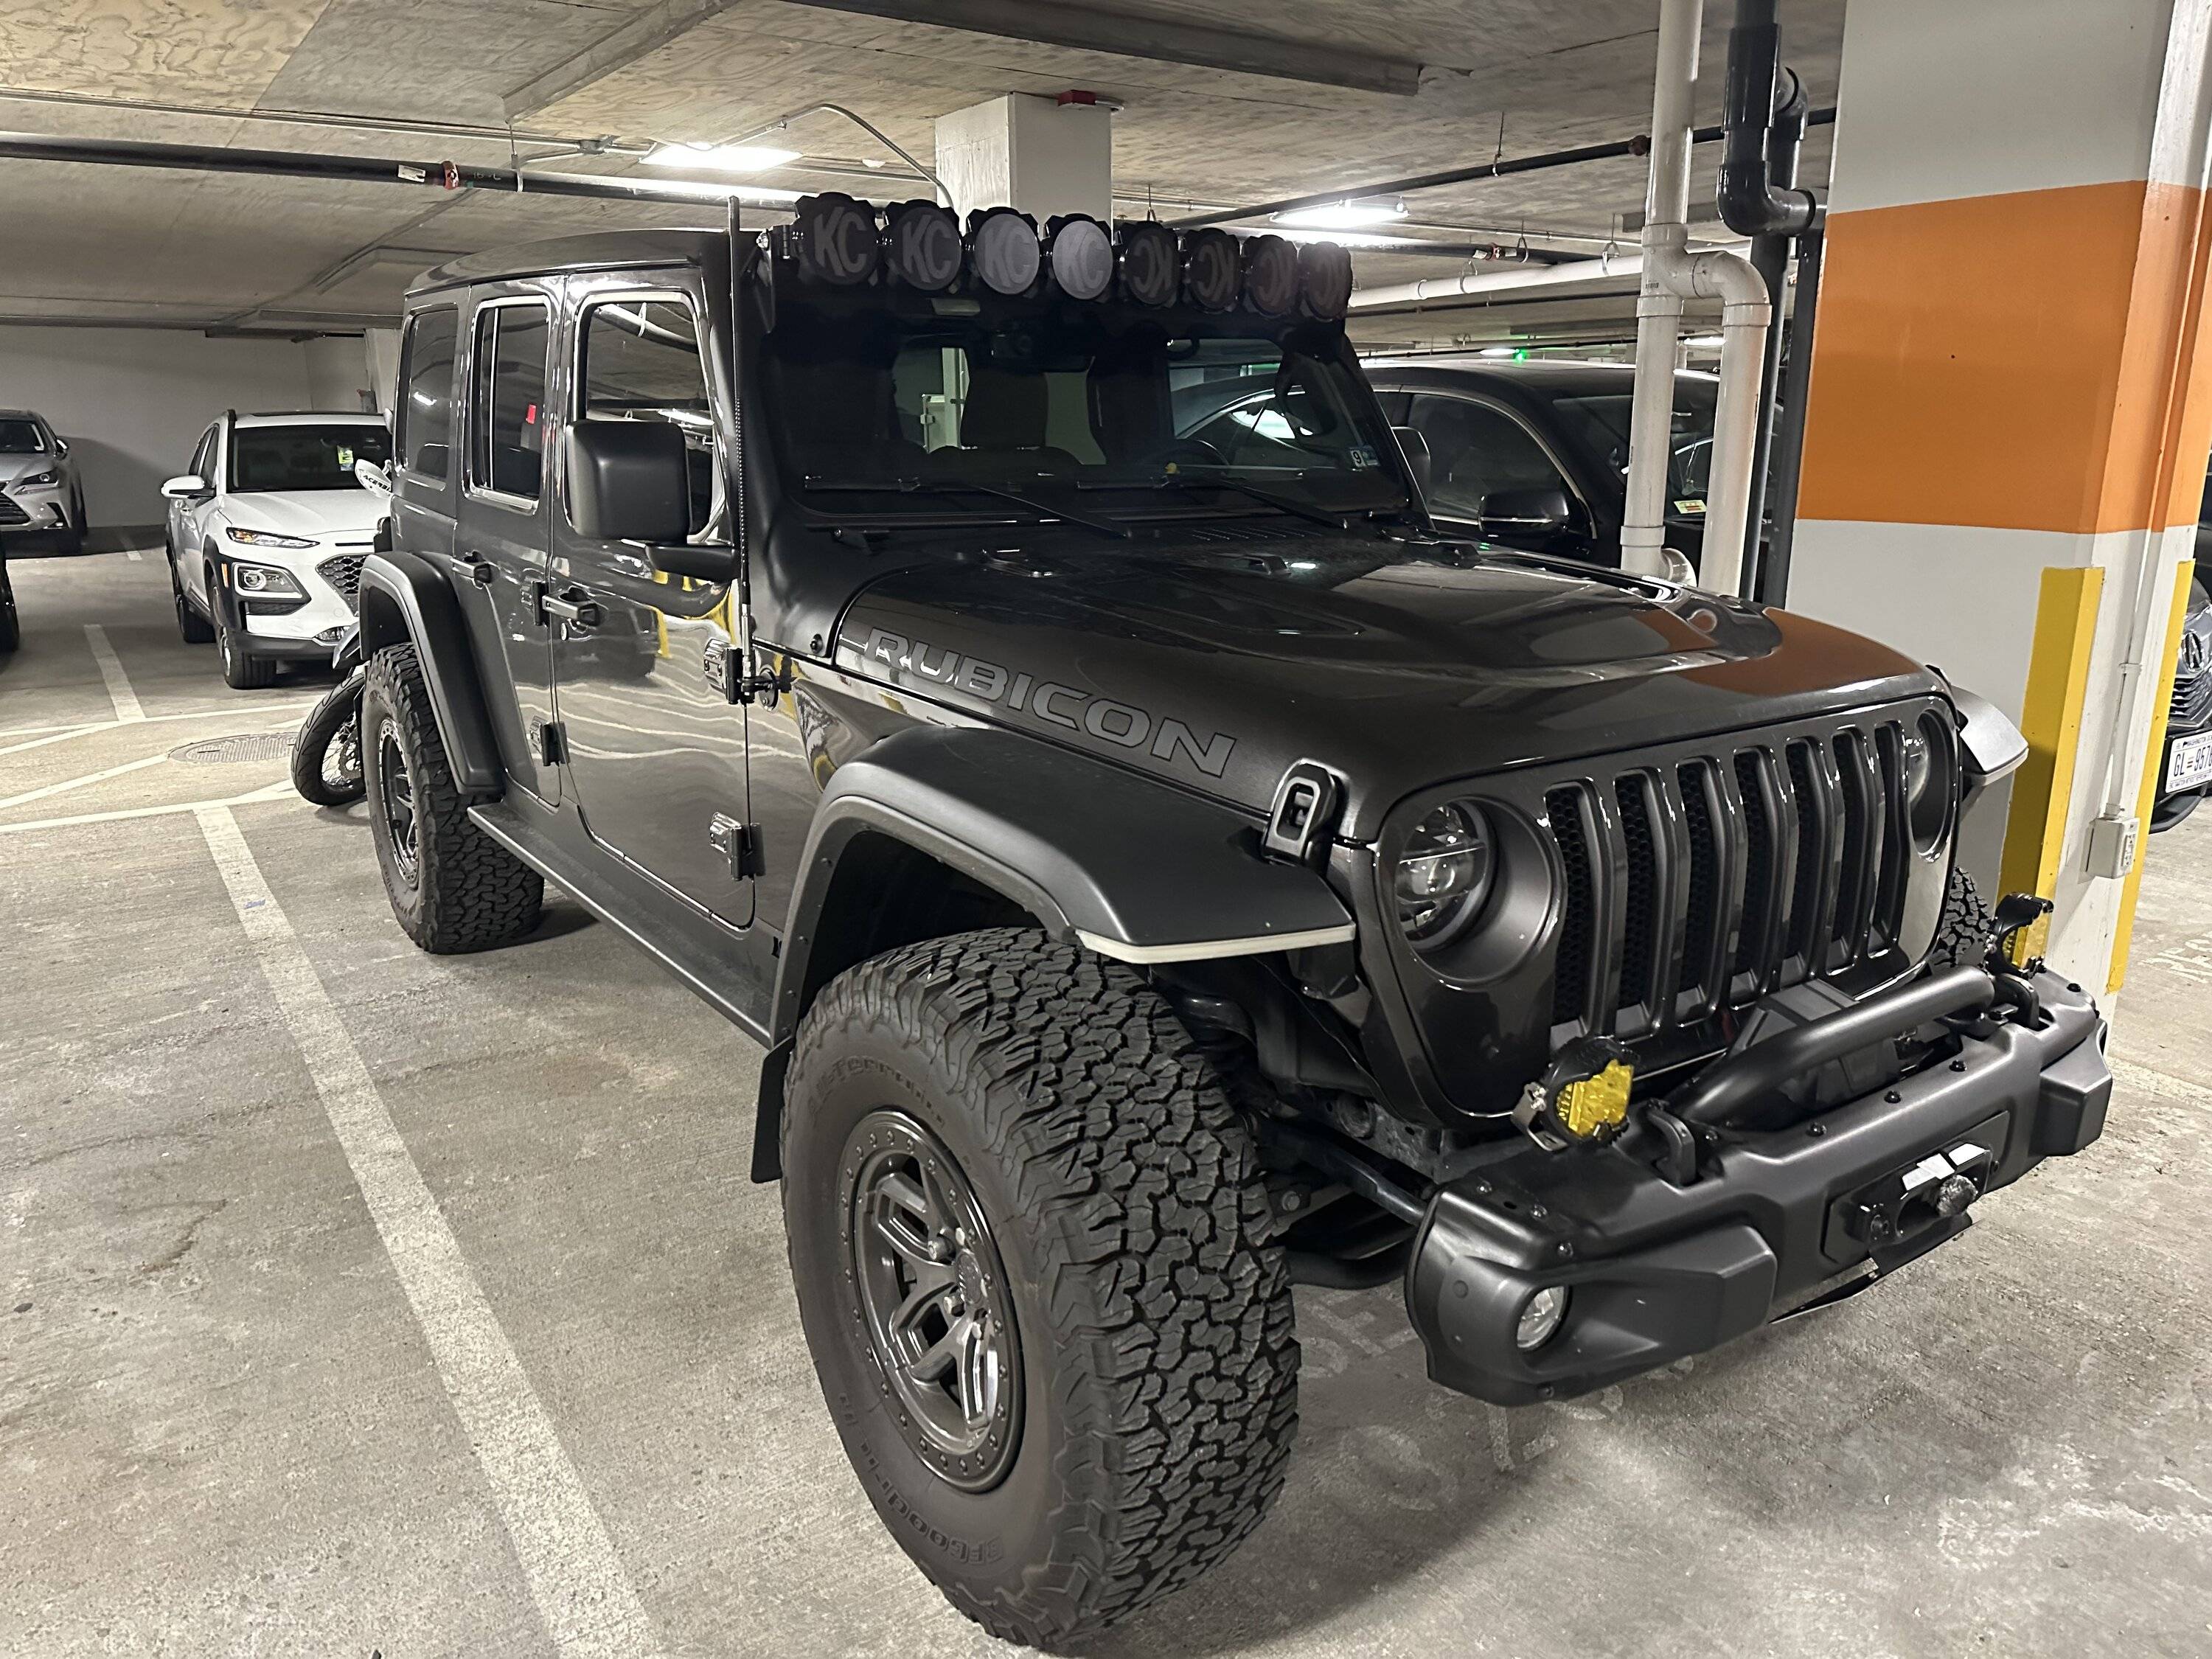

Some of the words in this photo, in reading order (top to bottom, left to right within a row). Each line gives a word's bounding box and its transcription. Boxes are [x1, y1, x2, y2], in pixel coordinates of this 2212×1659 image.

[814, 206, 867, 276] KC
[902, 215, 952, 282] KC
[984, 220, 1032, 288] KC
[1062, 229, 1104, 293] KC
[1353, 451, 1362, 464] 9
[864, 627, 1237, 778] RUBICON
[2174, 751, 2185, 776] GL
